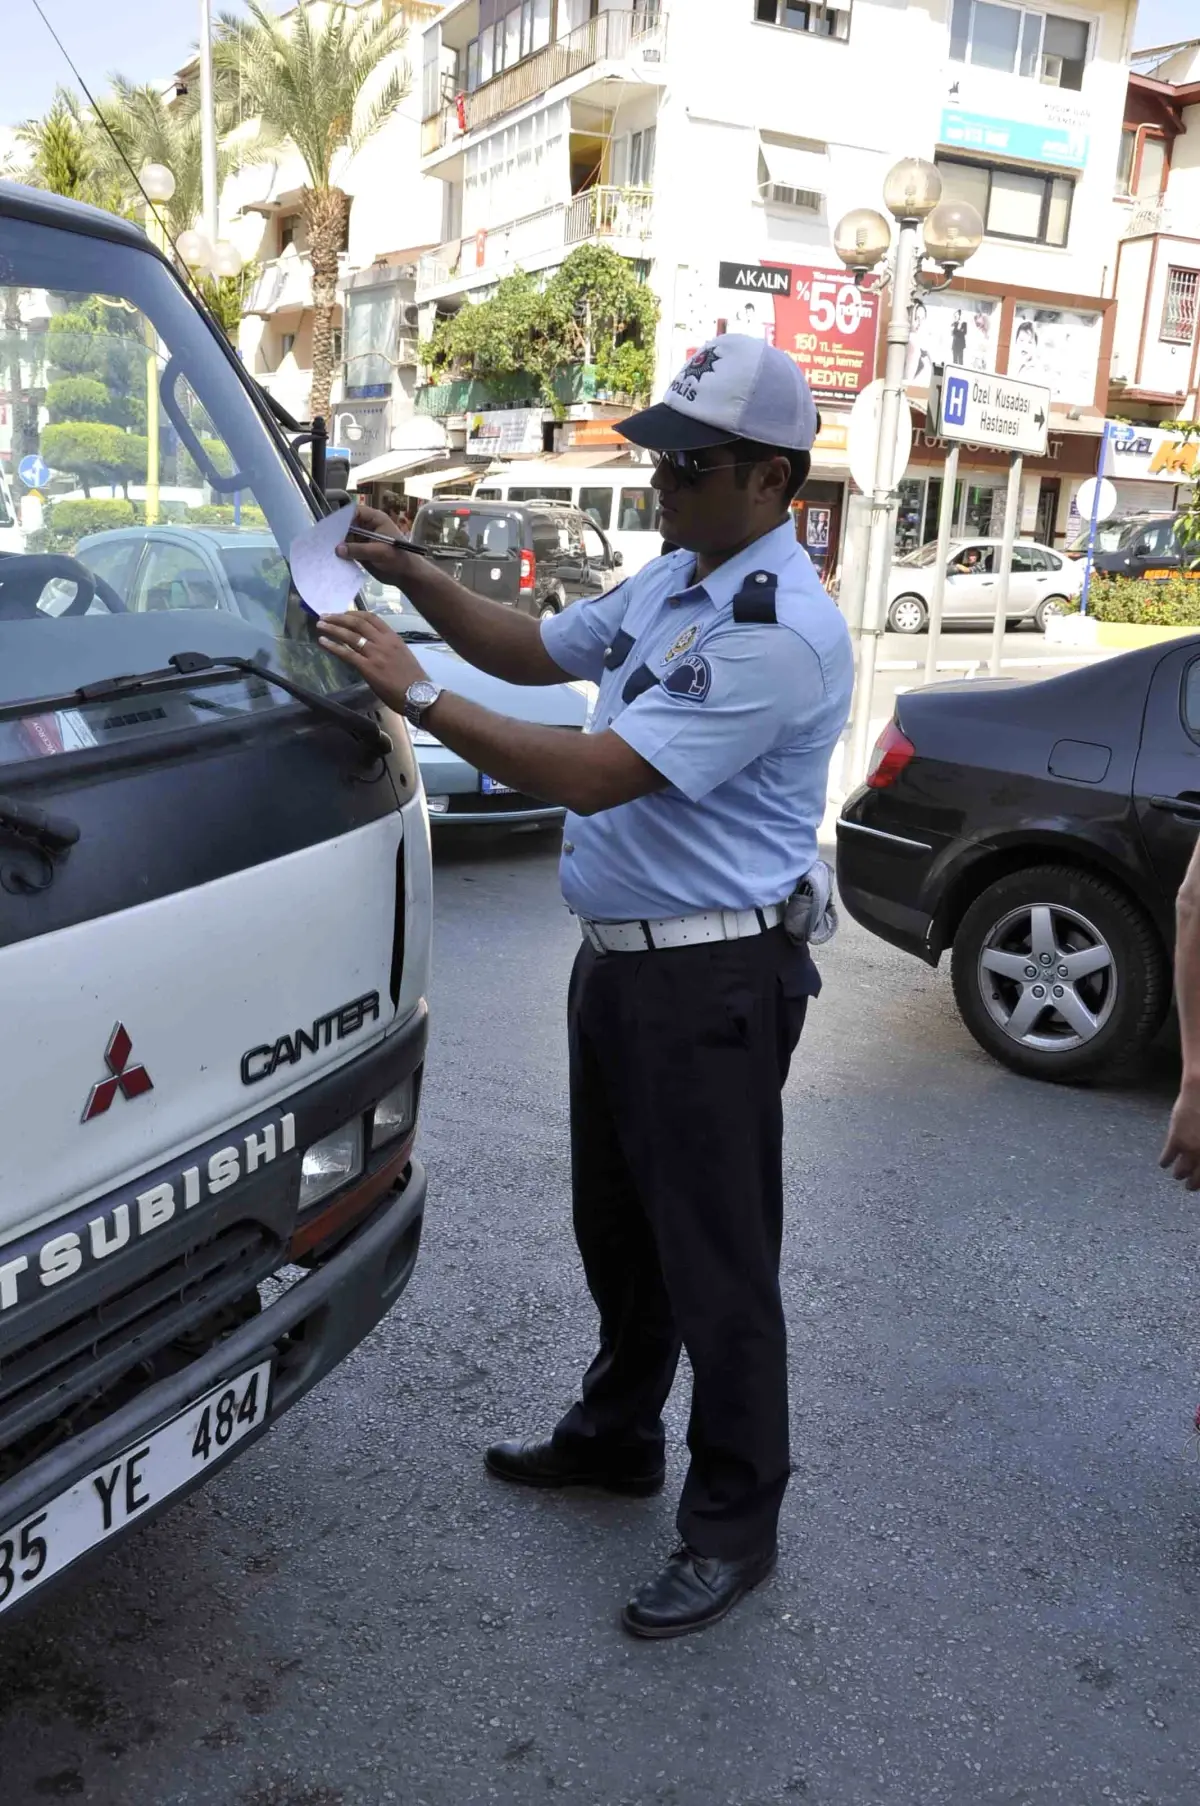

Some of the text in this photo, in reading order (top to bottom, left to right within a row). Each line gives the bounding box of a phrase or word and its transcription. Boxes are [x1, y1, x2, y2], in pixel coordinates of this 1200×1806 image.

[735, 269, 789, 290] AKALIN
[794, 333, 818, 351] 150
[972, 379, 991, 405] Özel
[980, 411, 1020, 436] Hastanesi
[240, 989, 379, 1085] CANTER
[0, 1112, 296, 1309] TSUBISHI
[93, 1447, 150, 1530] YE
[192, 1372, 259, 1460] 484
